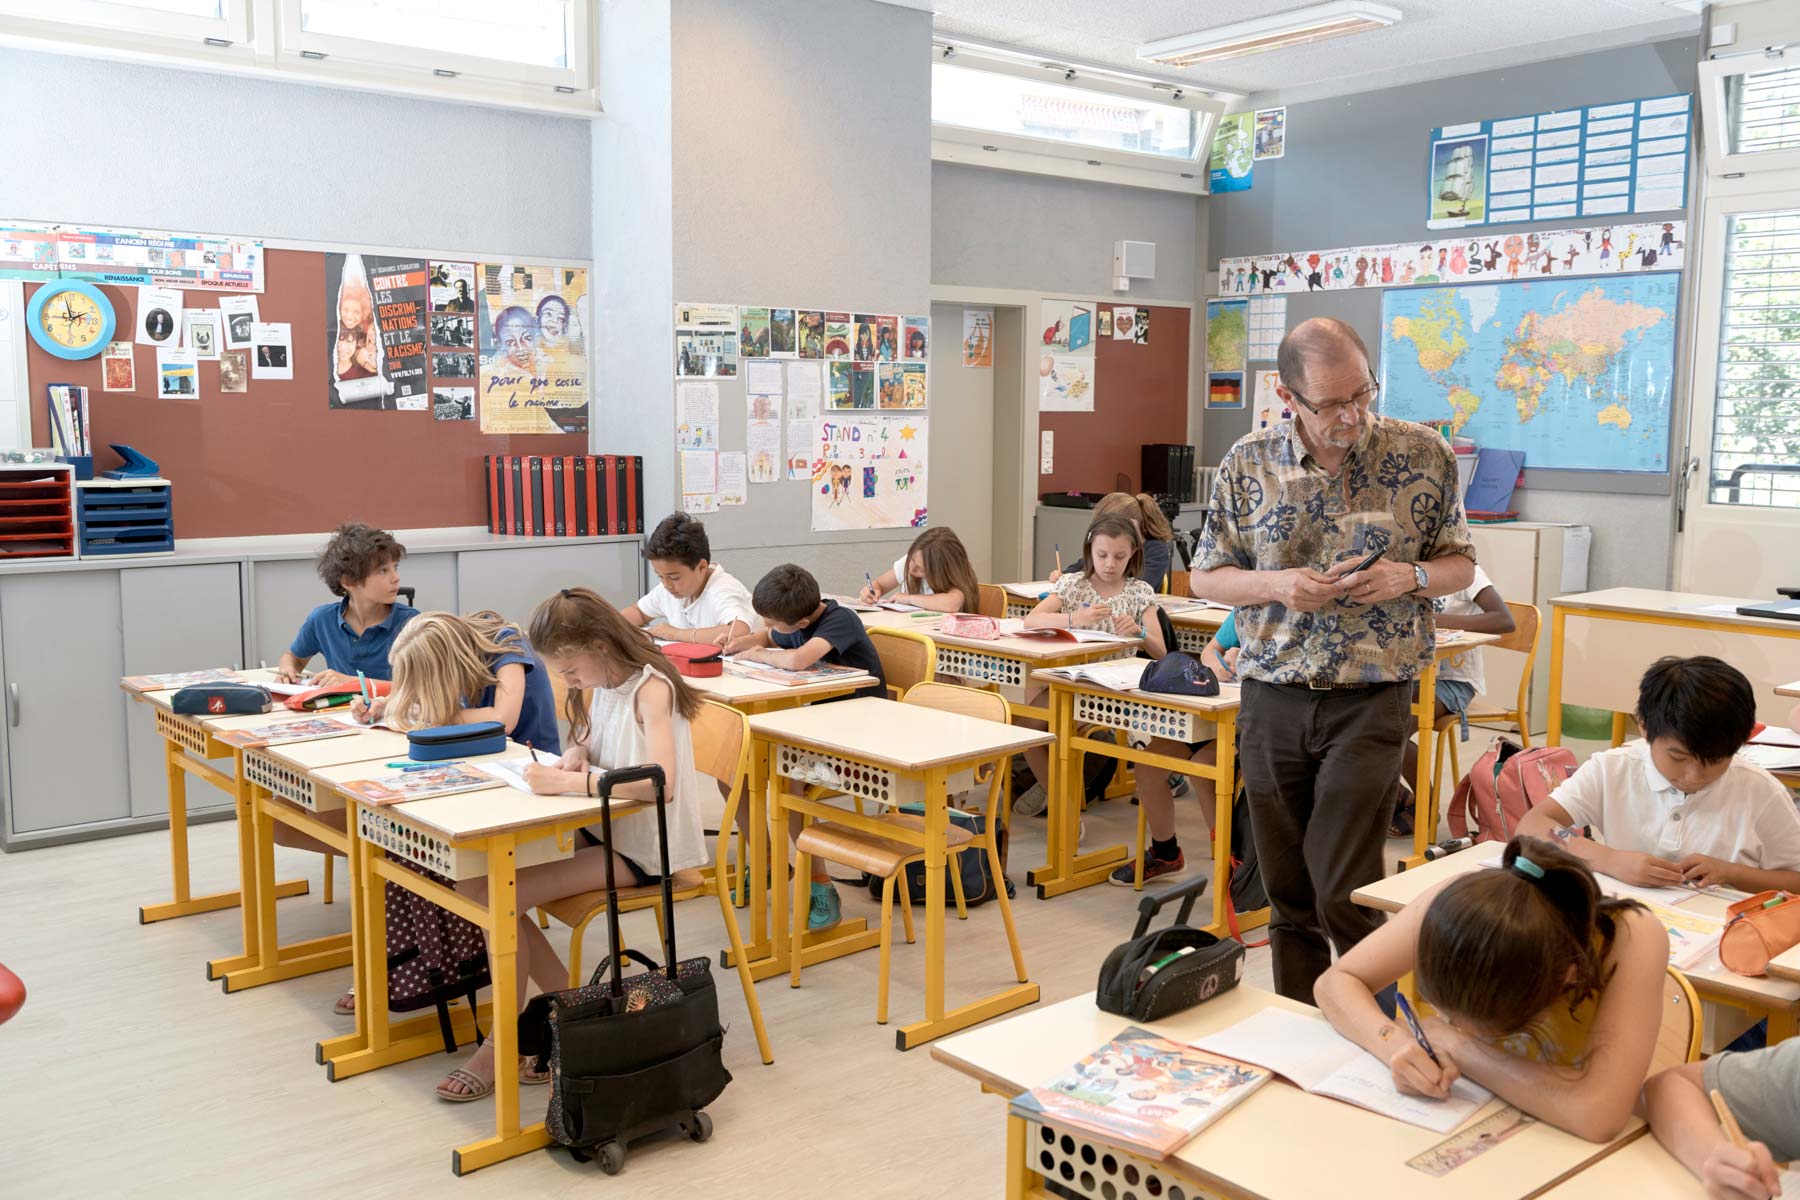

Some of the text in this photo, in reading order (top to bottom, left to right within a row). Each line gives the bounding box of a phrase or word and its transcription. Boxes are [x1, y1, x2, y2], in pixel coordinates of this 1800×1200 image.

[373, 274, 408, 291] CONTRE
[375, 290, 393, 305] LES
[382, 315, 418, 332] NATIONS
[383, 330, 411, 346] ET LE
[387, 342, 425, 359] RACISME
[487, 375, 581, 394] pour que cesse
[508, 391, 519, 409] le
[821, 422, 861, 442] STAND
